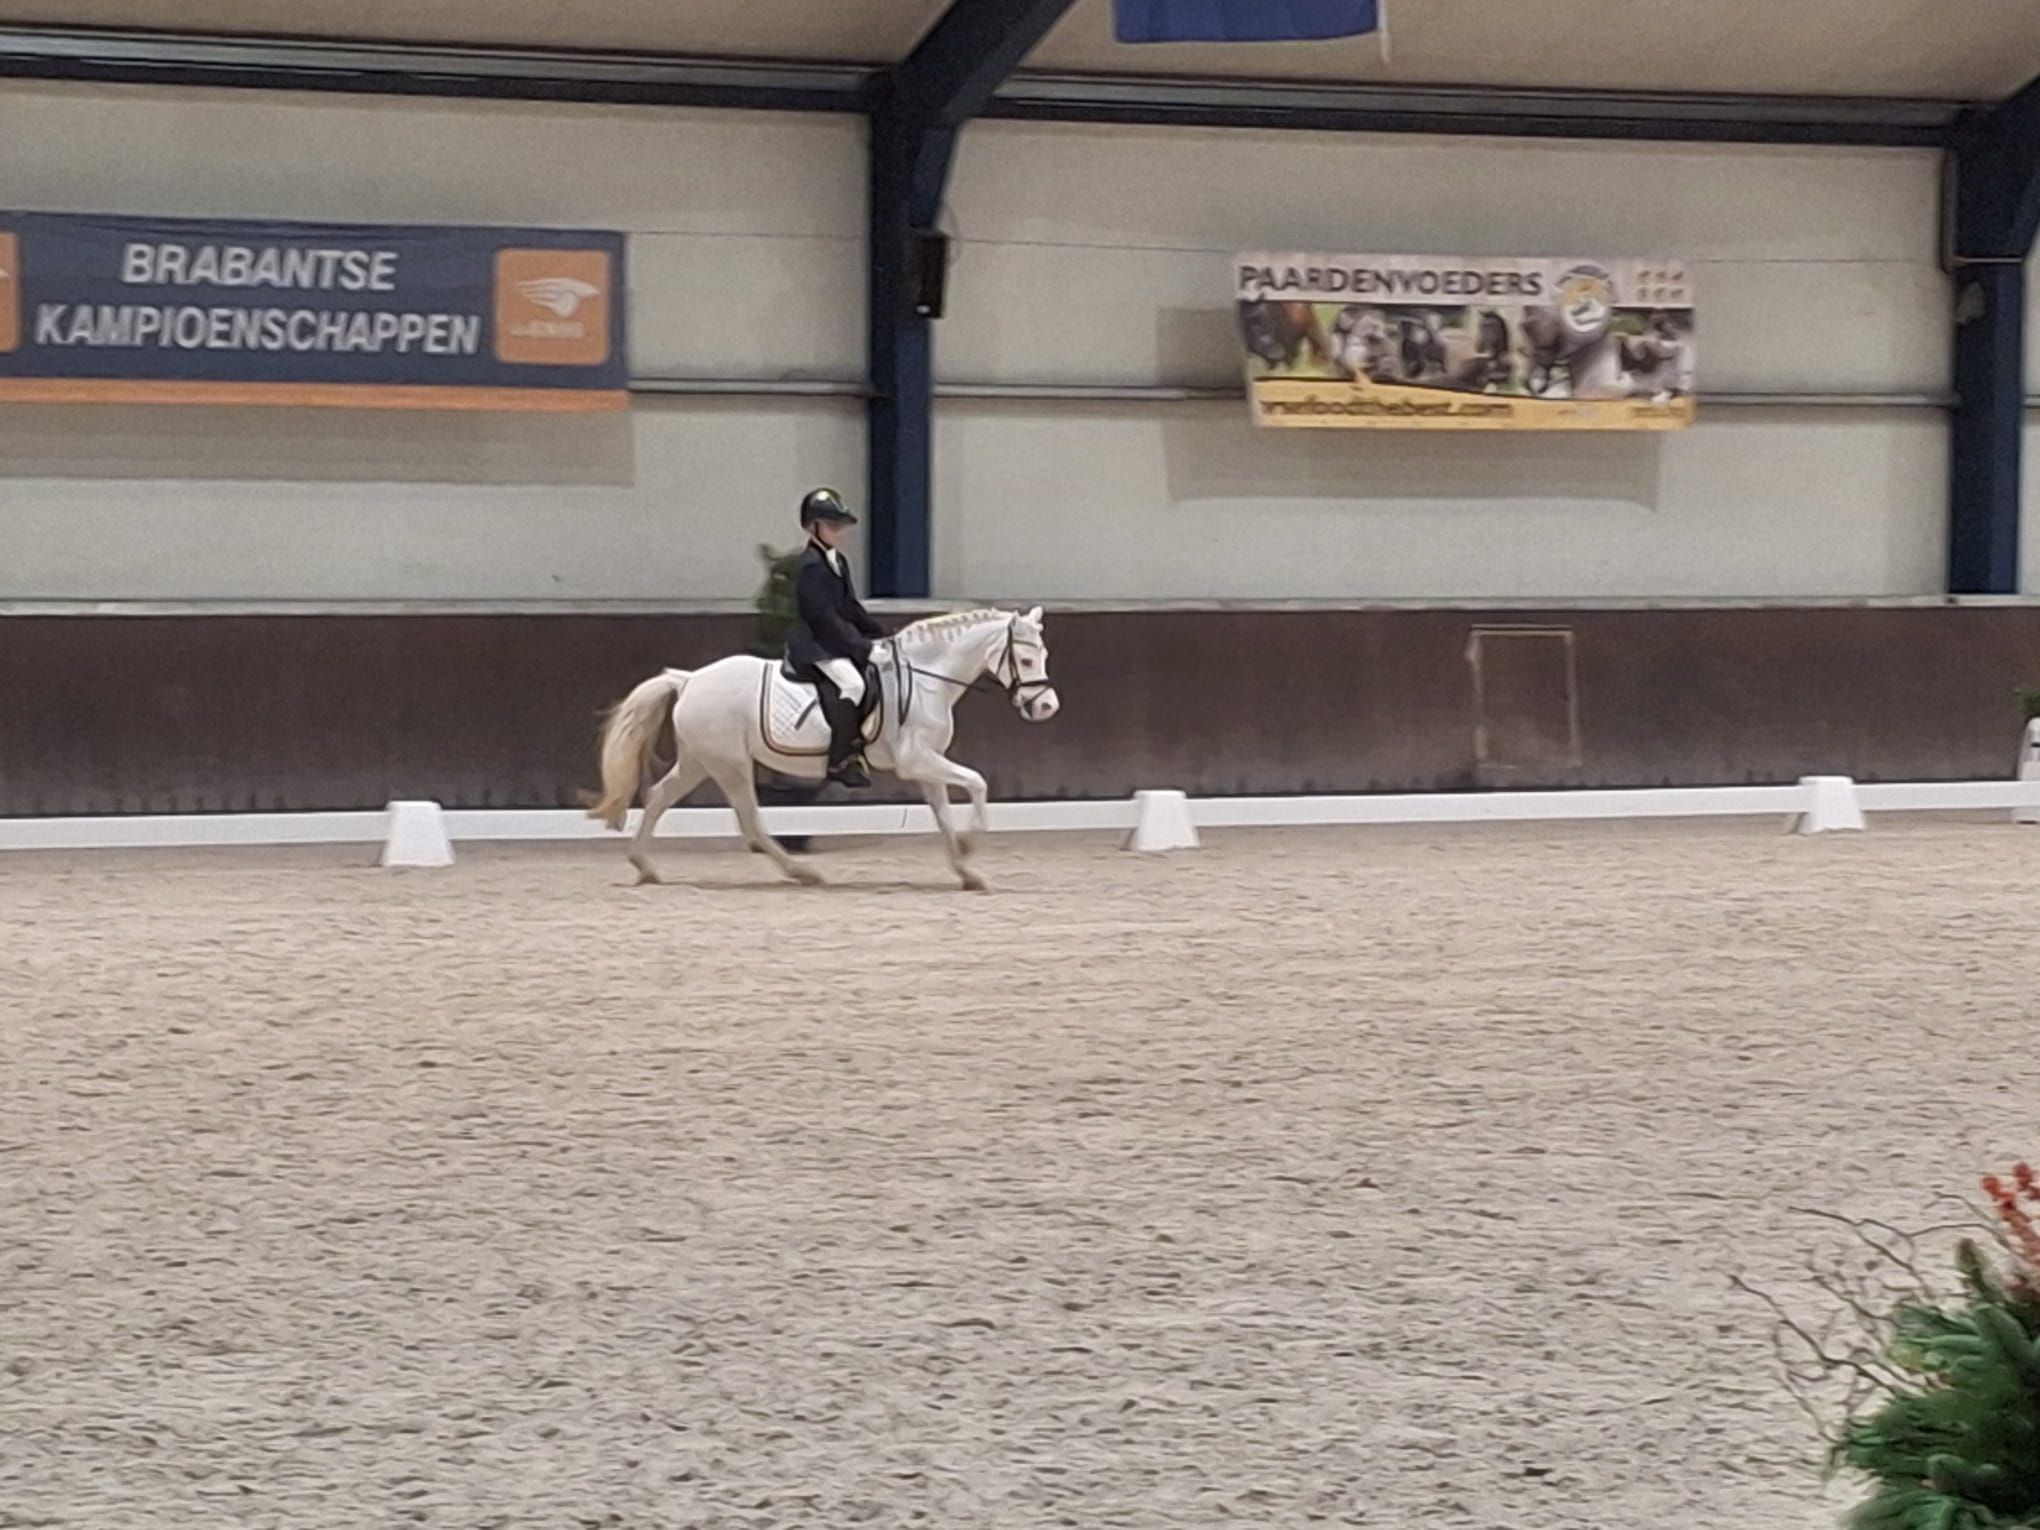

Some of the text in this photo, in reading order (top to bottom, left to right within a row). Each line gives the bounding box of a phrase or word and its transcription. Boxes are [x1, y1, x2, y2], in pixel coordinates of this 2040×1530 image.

[122, 243, 397, 291] BRABANTSE
[1239, 265, 1543, 295] PAARDENVOEDERS
[35, 303, 480, 354] KAMPIOENSCHAPPEN
